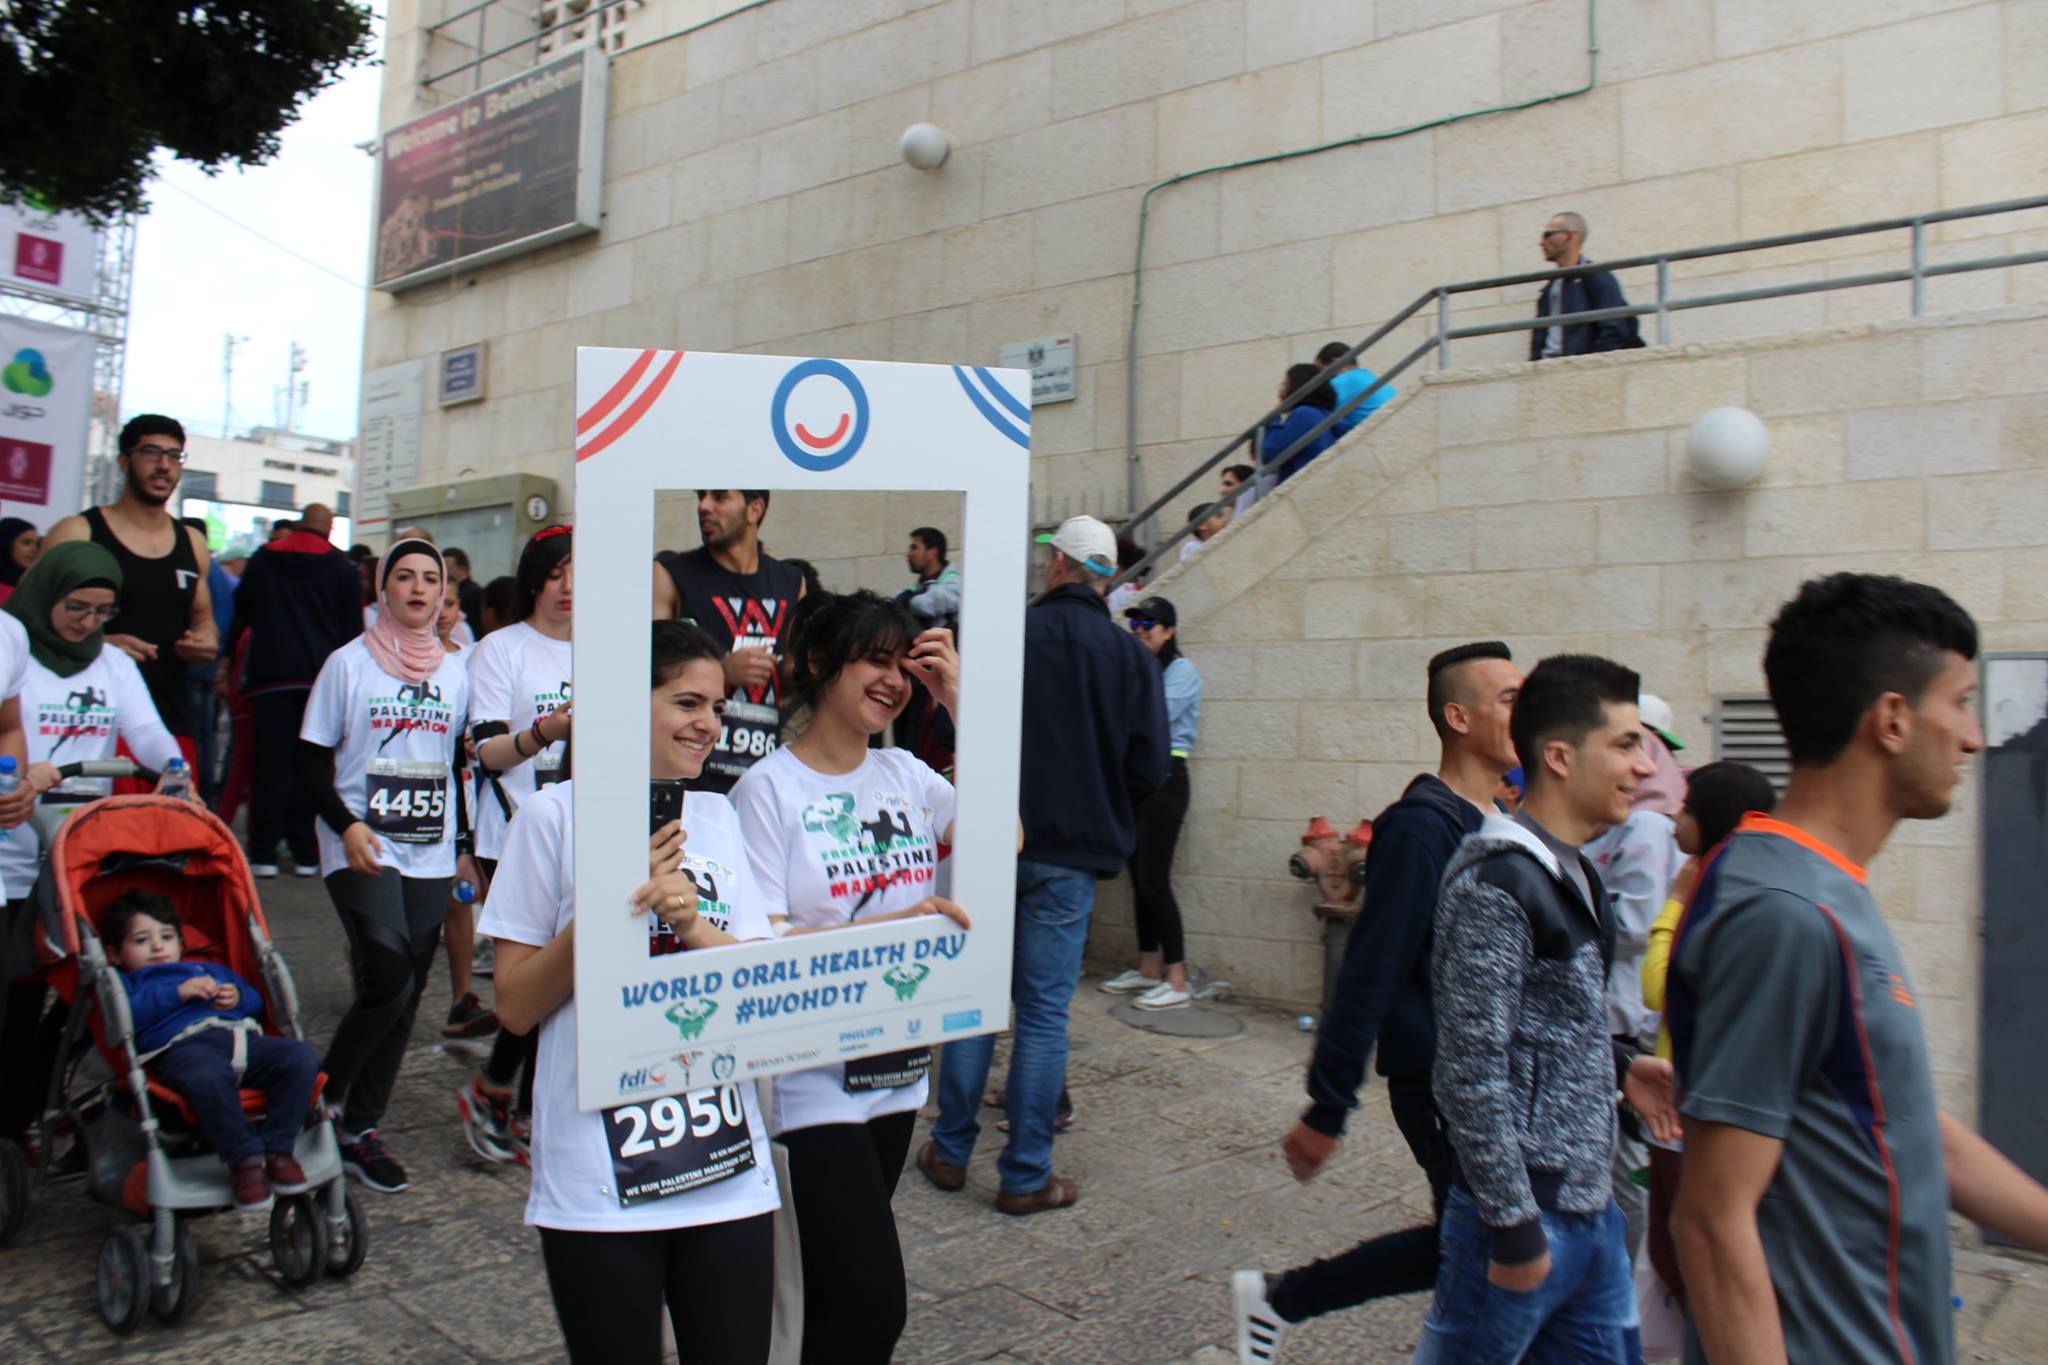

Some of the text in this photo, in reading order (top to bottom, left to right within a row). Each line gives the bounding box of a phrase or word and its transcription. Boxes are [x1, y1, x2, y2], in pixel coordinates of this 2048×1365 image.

[370, 706, 451, 722] PALESTINE
[714, 726, 777, 757] 1986
[370, 788, 445, 818] 4455
[826, 848, 933, 879] PALESTINE
[830, 866, 934, 899] MARATHON
[621, 933, 966, 1009] WORLD ORAL HEALTH DAY
[735, 981, 868, 1026] #WOHD17
[613, 1083, 744, 1159] 2950
[625, 1186, 640, 1197] WE
[641, 1181, 660, 1193] RUN
[660, 1169, 703, 1188] PALESTINE
[703, 1156, 739, 1175] MARATHON
